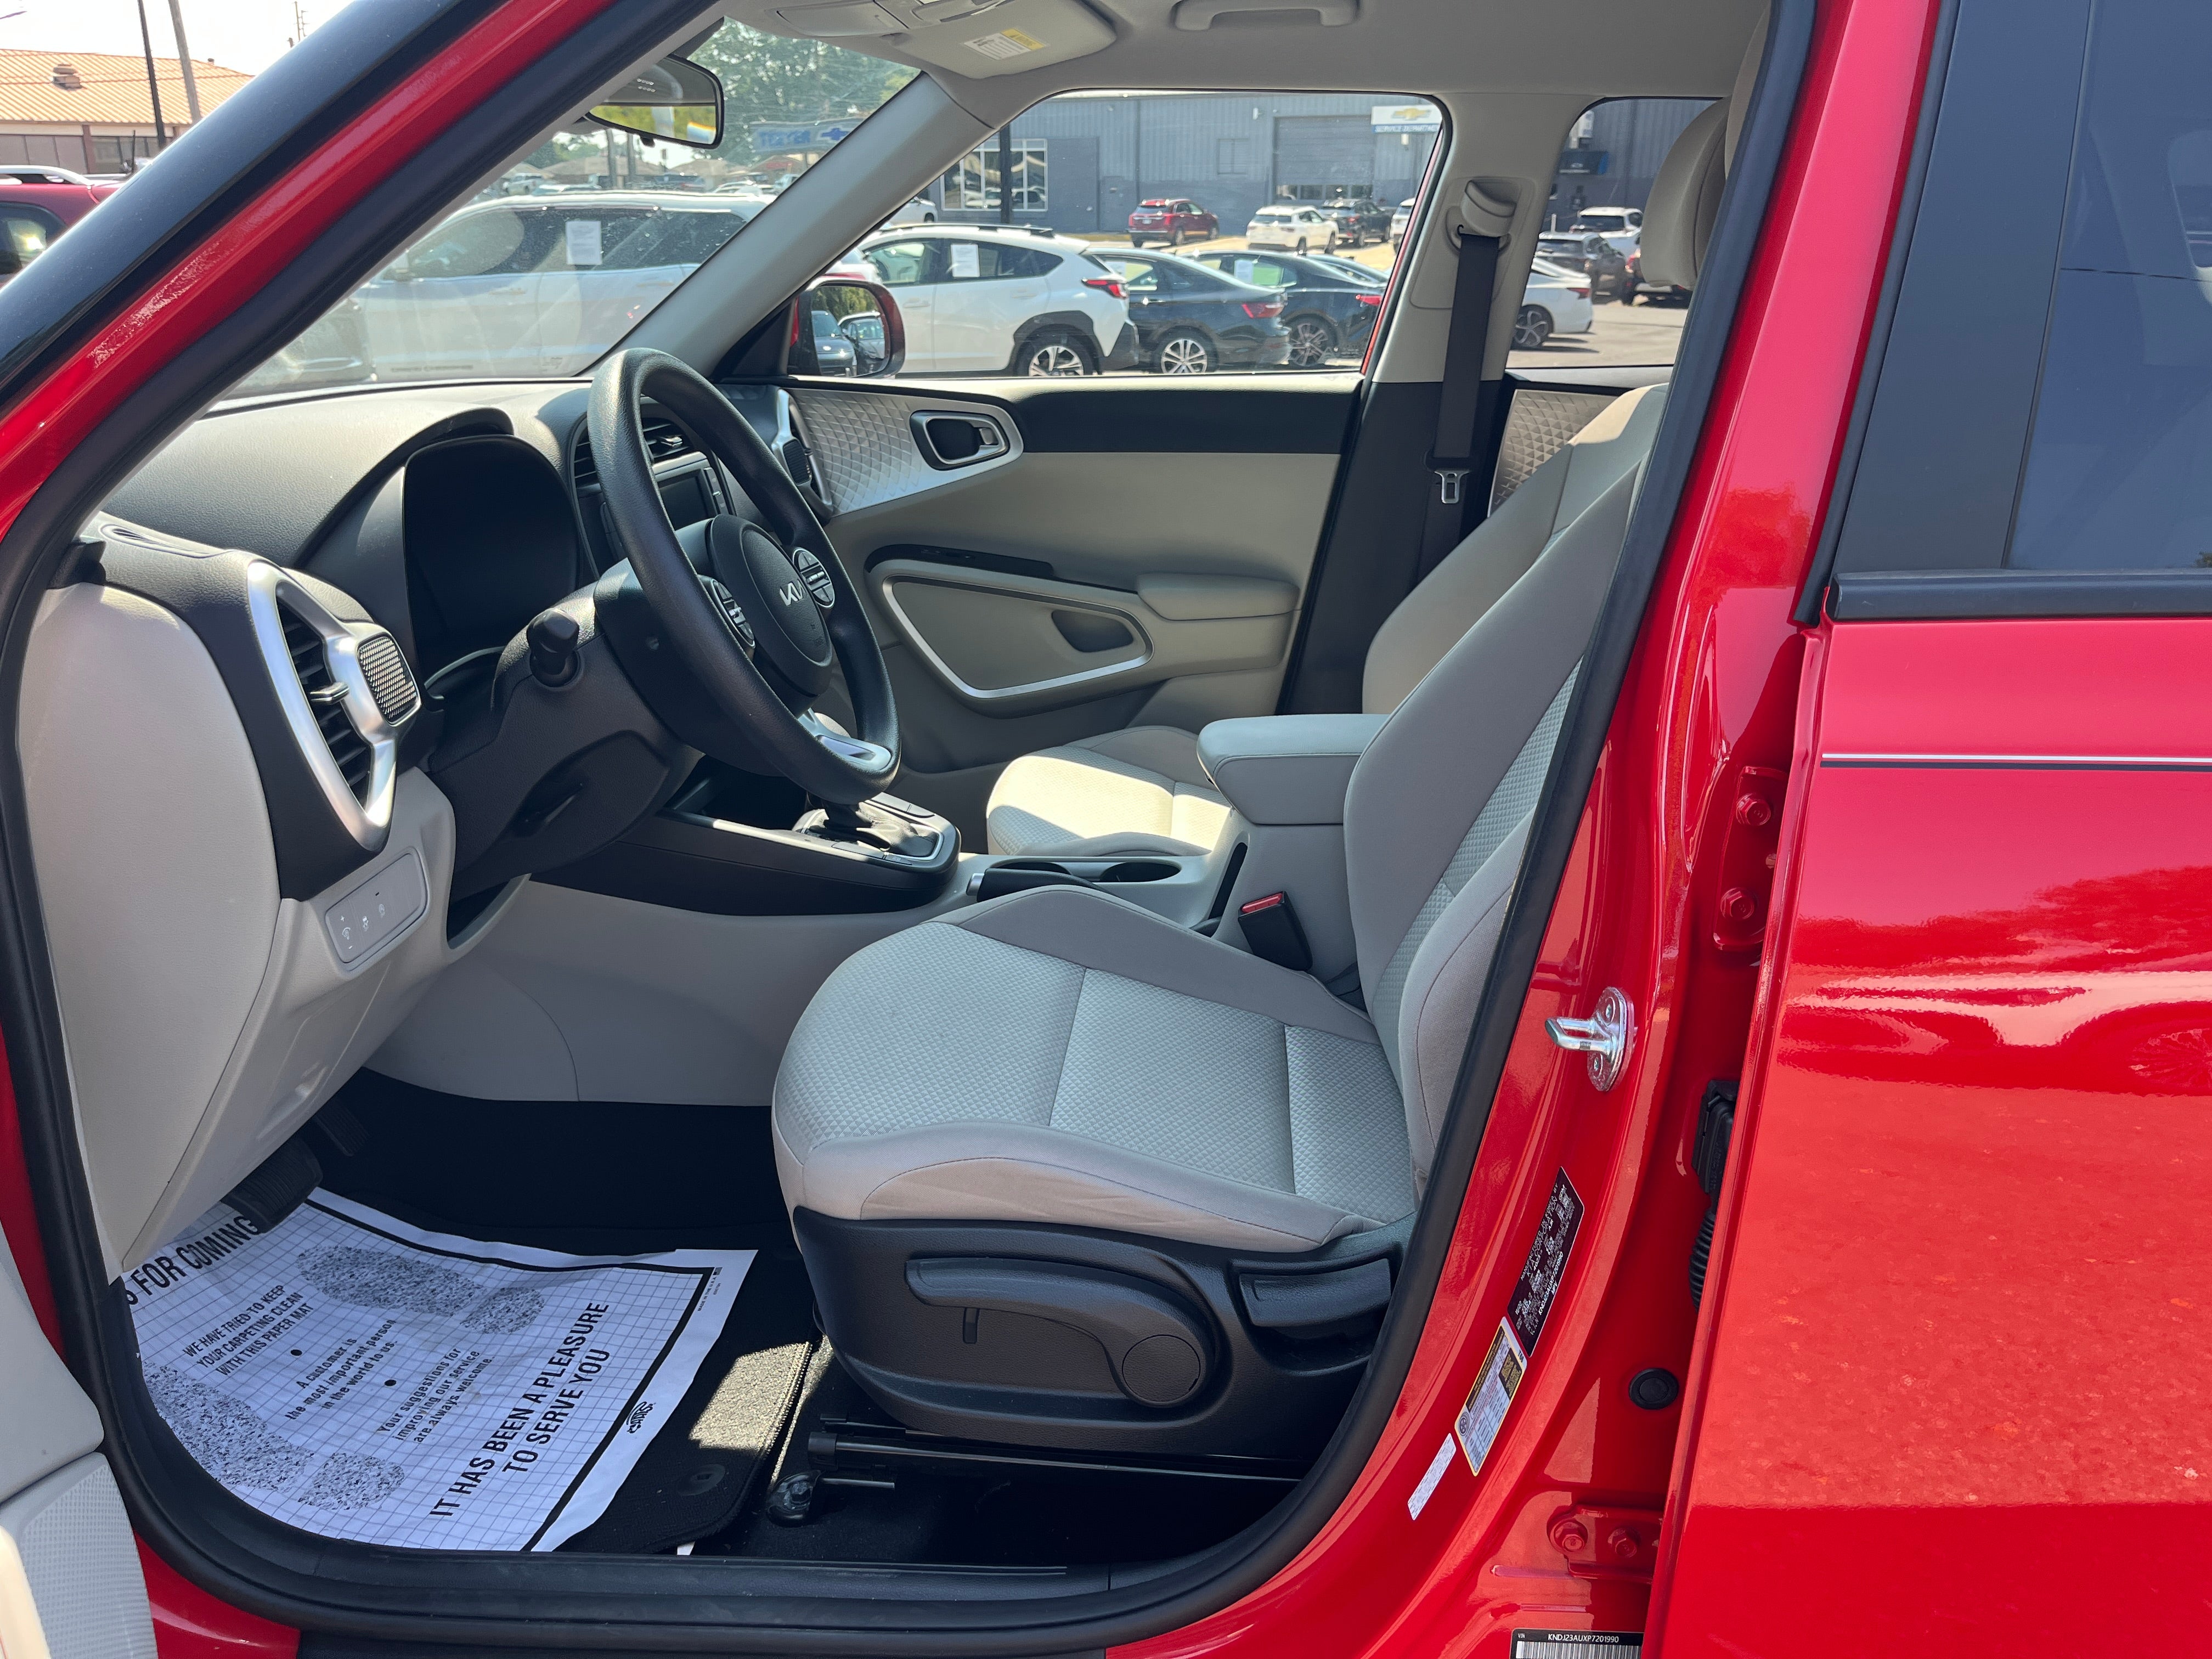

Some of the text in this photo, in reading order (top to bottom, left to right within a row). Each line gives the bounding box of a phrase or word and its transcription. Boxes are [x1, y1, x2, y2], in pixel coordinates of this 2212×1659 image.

[130, 1215, 261, 1296] FOR COMING
[183, 1285, 285, 1357] WE HAVE TRIED TO KEEP
[197, 1292, 303, 1368] YOUR CARPETING CLEAN
[216, 1302, 314, 1375] WITH THIS PAPER MAT
[285, 1319, 397, 1420] the most important person
[296, 1338, 357, 1389] A customer is
[322, 1401, 334, 1409] in
[330, 1386, 350, 1401] the
[346, 1362, 374, 1385] world
[369, 1353, 383, 1365] to
[376, 1348, 461, 1433] Your suggestions for
[392, 1351, 480, 1441] improving our service
[414, 1356, 494, 1443] are always welcome.
[430, 1303, 609, 1516] IT HAS BEEN A PLEASURE
[502, 1348, 610, 1472] TO SERVE YOU
[1548, 1633, 1619, 1643] KNDJ23AUXP7201990
